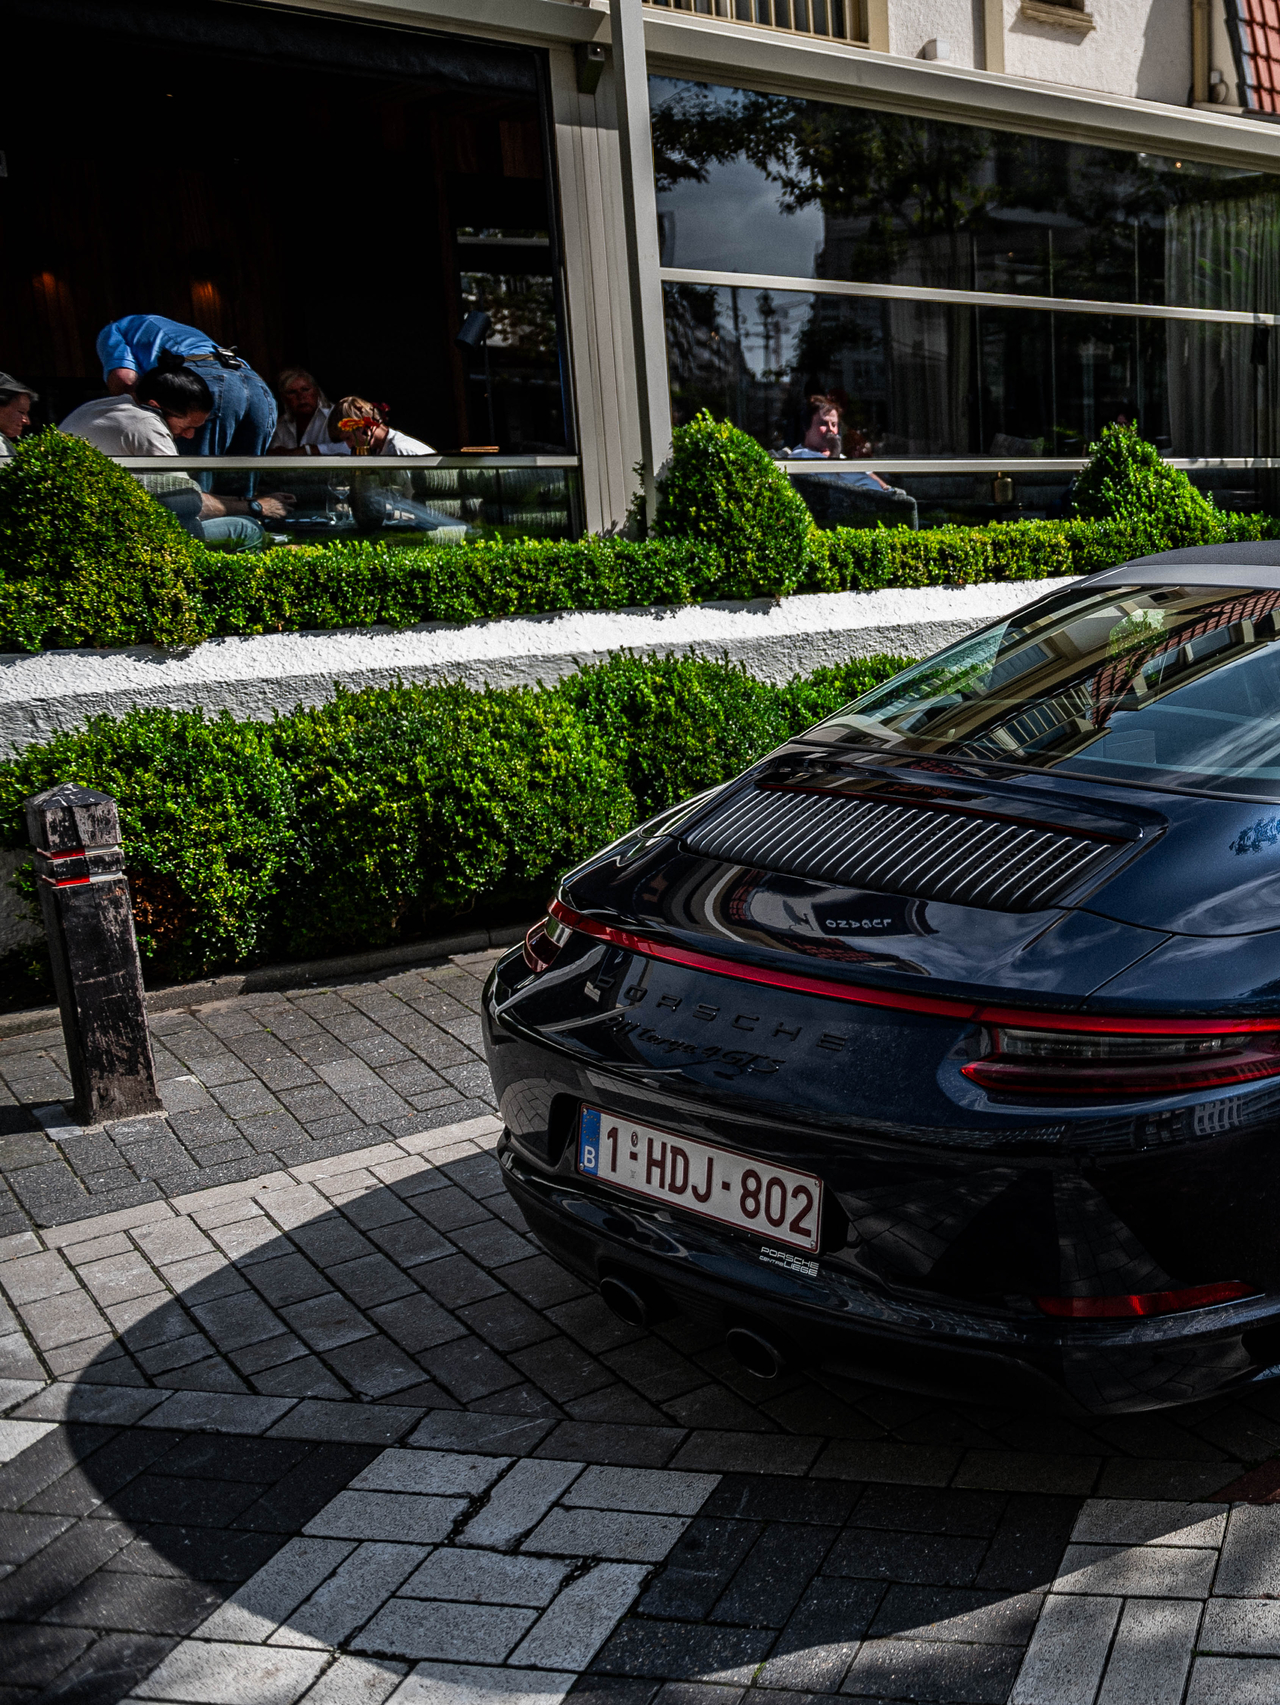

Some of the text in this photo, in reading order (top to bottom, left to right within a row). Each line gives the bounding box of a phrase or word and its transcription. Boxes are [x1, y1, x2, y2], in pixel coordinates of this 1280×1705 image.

[595, 974, 848, 1052] PORSCHE
[602, 1015, 641, 1036] 911
[584, 1145, 596, 1169] B
[606, 1126, 814, 1238] 1-HDJ-802
[760, 1246, 820, 1270] PORSCHE
